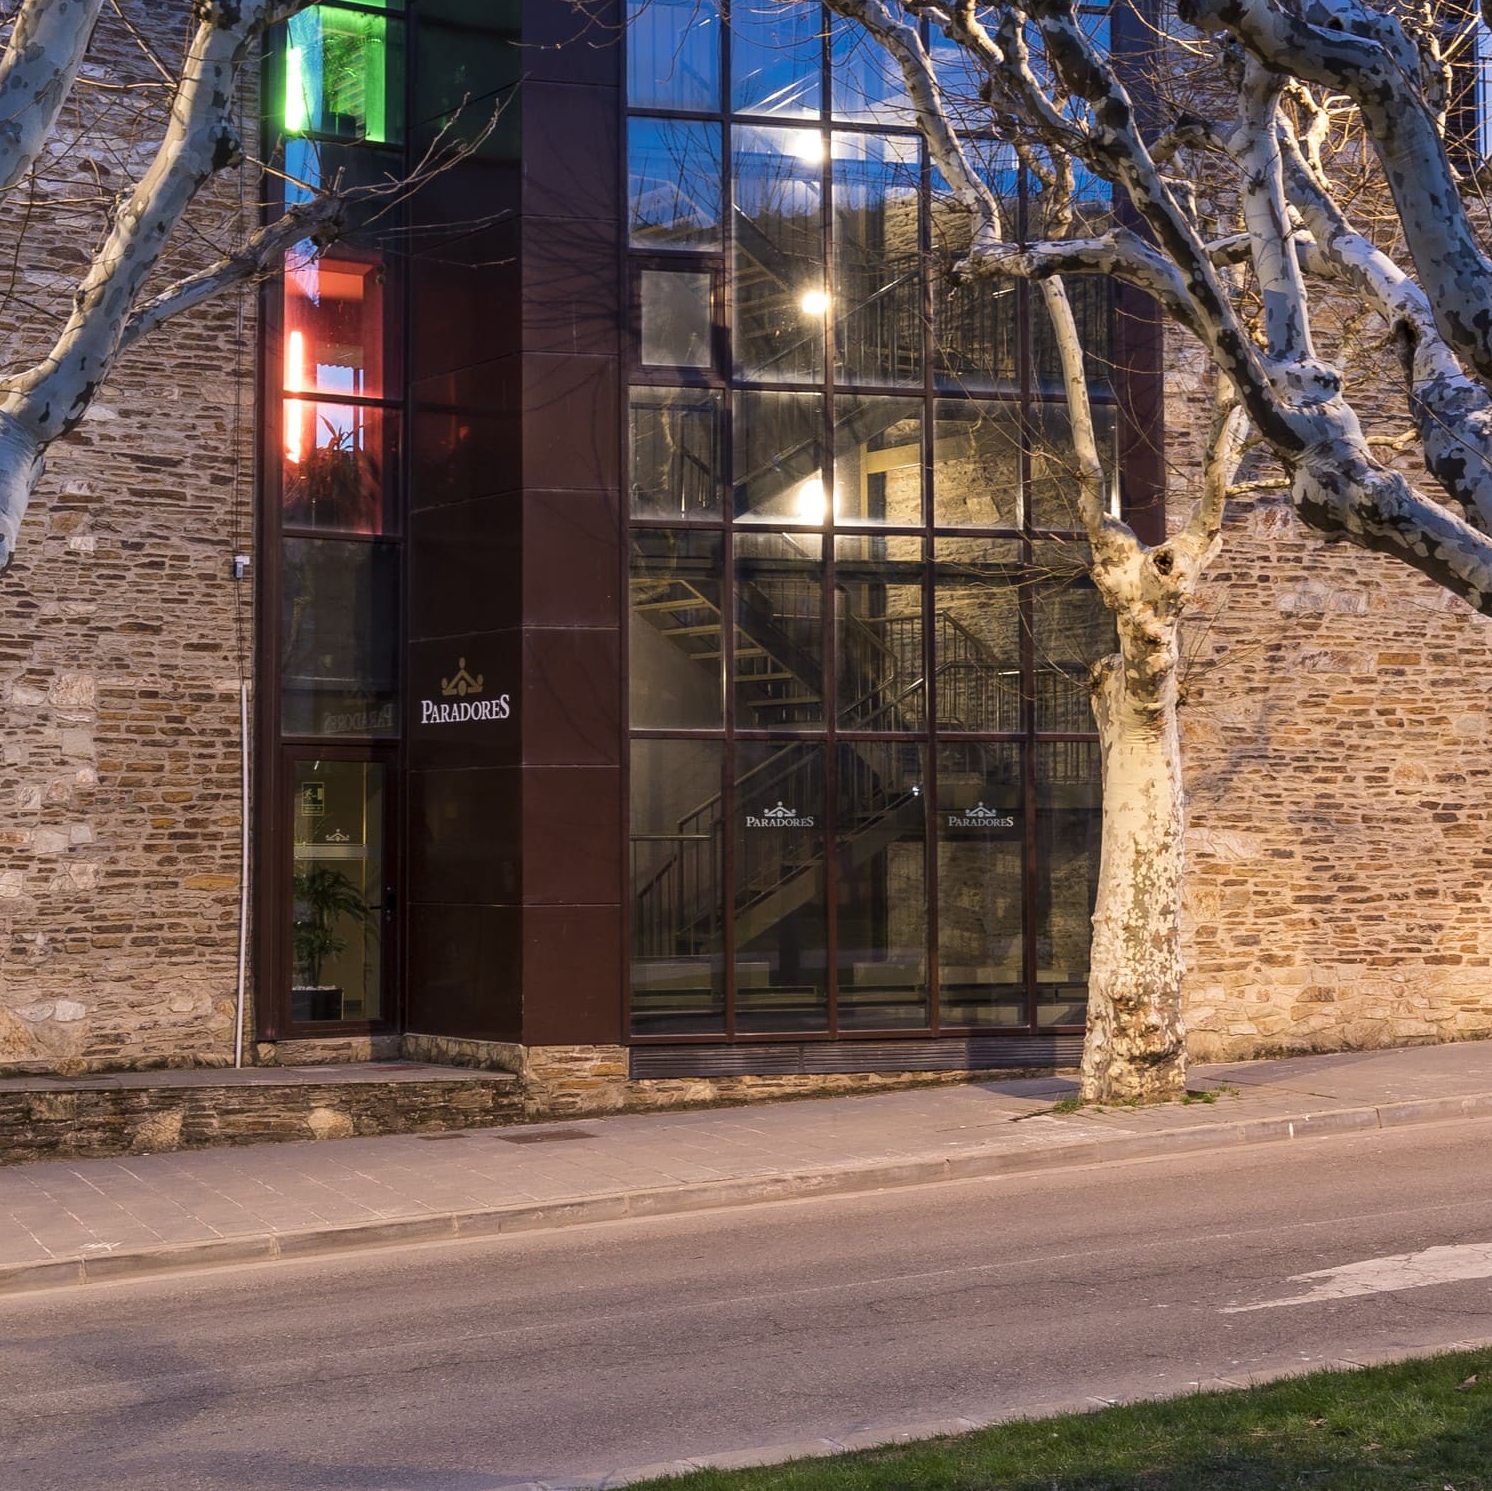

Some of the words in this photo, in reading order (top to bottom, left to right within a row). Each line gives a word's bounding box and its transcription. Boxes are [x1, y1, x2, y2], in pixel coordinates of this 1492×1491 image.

[420, 694, 510, 724] PARADORES
[745, 816, 814, 827] PARADORES
[948, 816, 1014, 827] PARADORES
